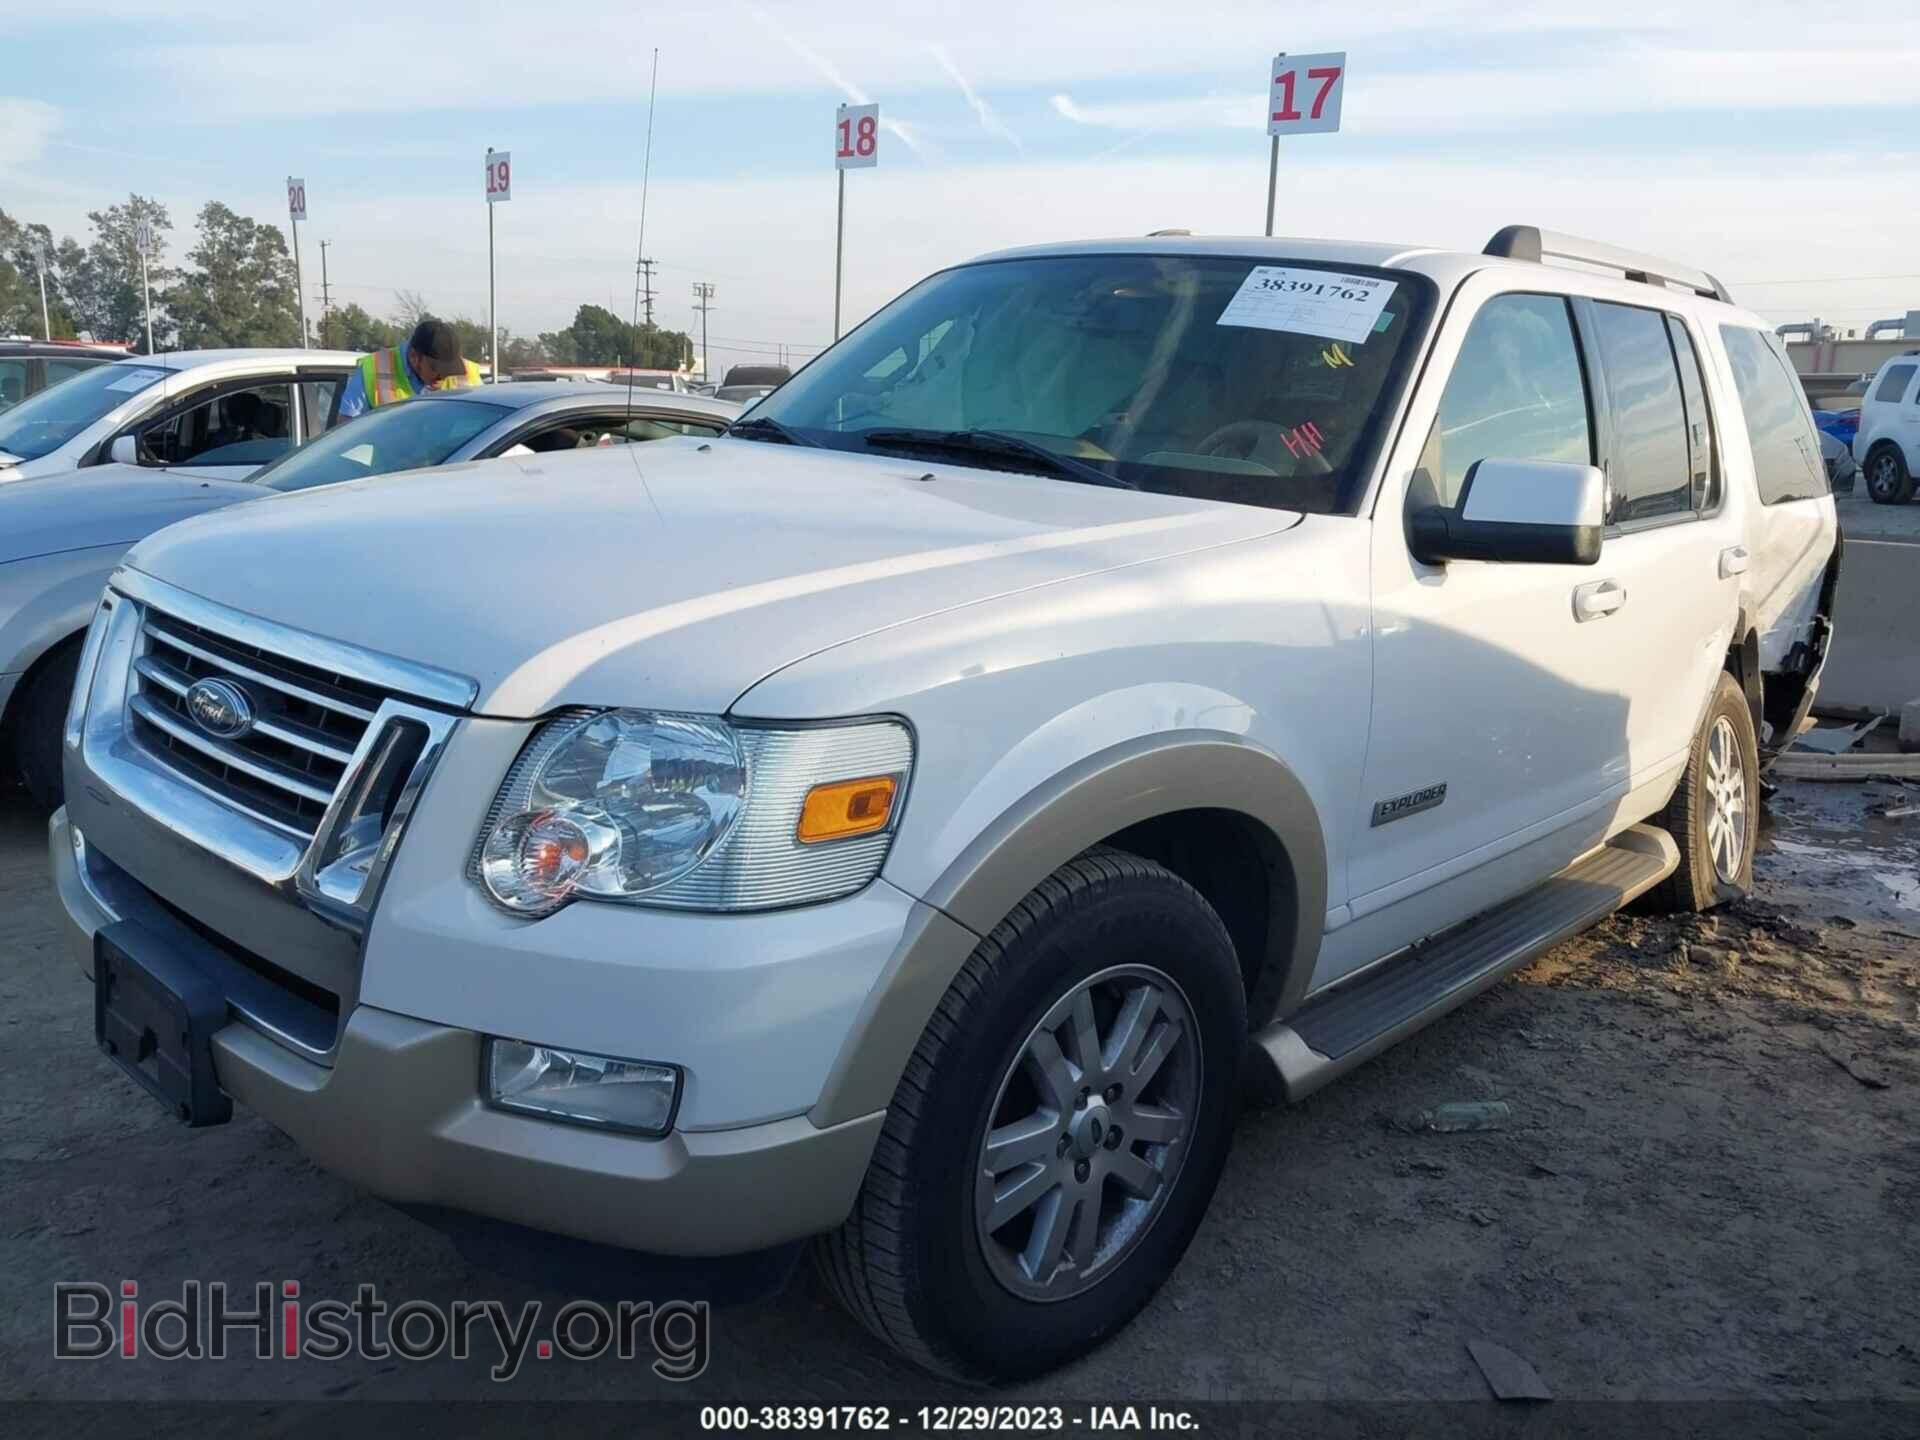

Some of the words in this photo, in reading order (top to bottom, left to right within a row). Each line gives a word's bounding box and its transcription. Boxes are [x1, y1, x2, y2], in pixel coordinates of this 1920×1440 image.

[1272, 67, 1341, 121] 17
[838, 116, 876, 157] 18
[487, 161, 509, 192] 19
[288, 186, 305, 212] 20
[1254, 277, 1370, 302] 38391762
[1380, 783, 1447, 816] EXPLORER
